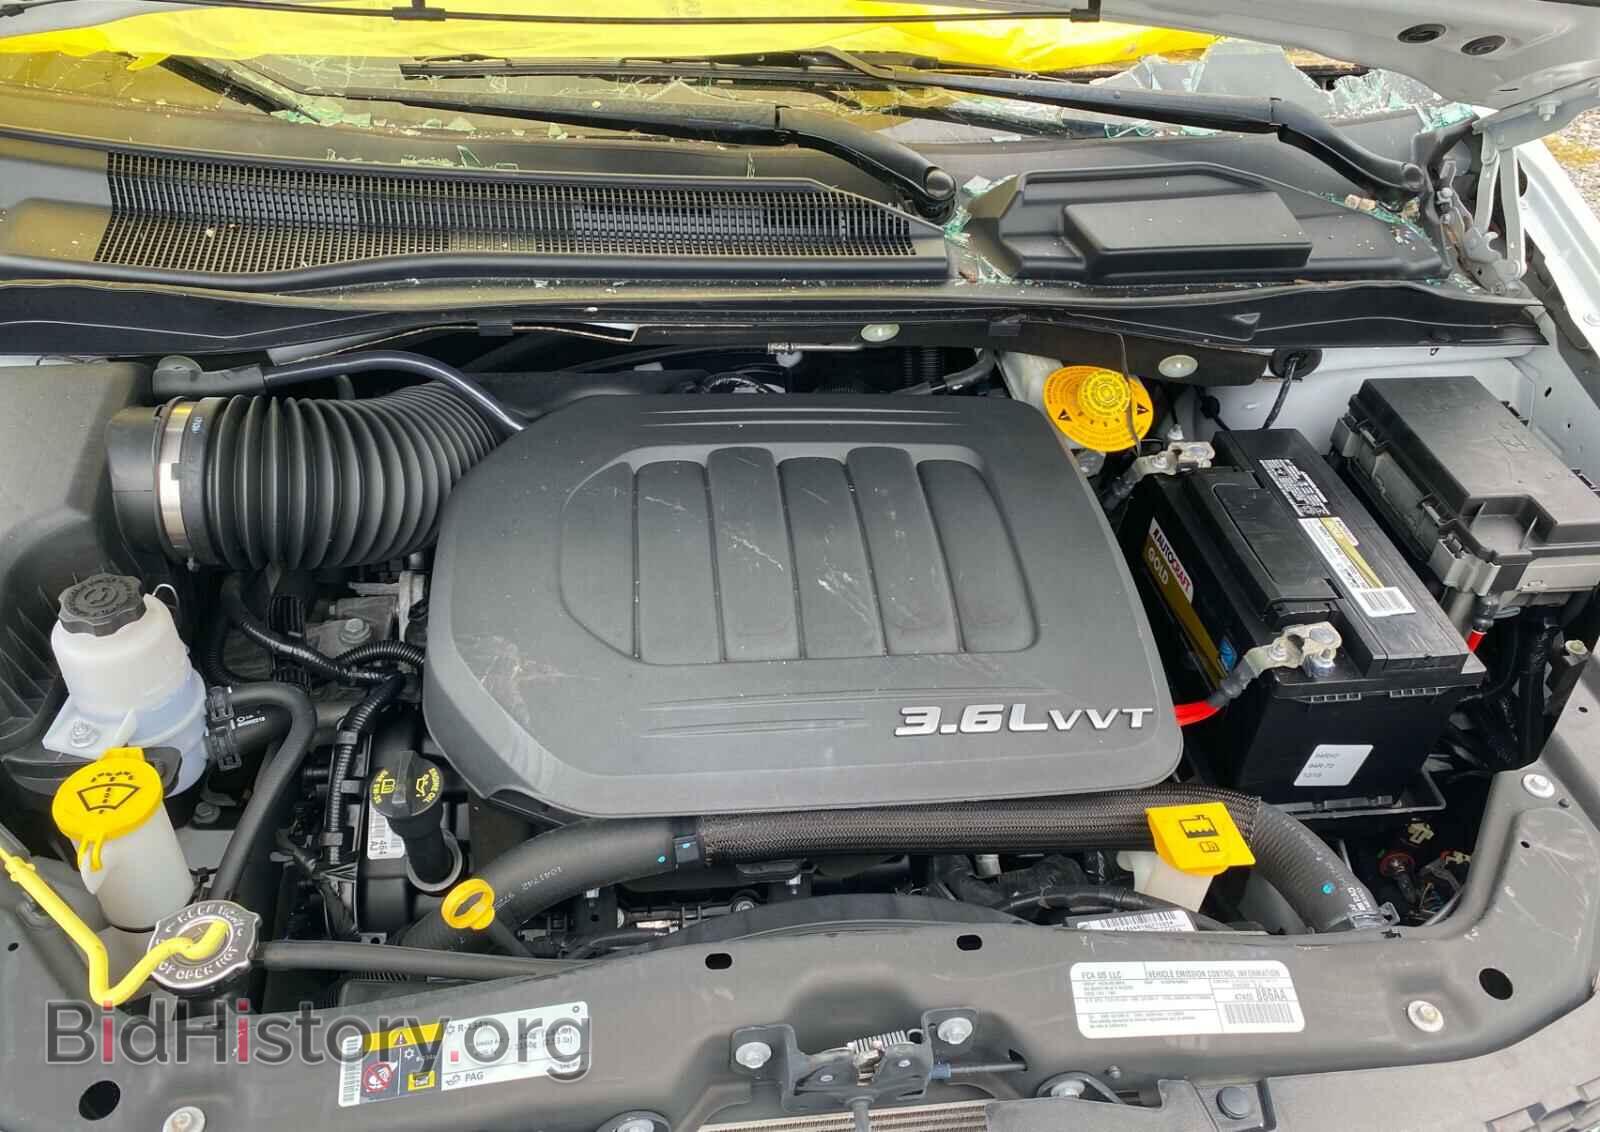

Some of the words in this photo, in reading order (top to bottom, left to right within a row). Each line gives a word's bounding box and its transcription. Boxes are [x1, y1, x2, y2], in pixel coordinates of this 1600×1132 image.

[1149, 543, 1169, 585] GOLD
[894, 703, 1048, 736] 3.6L
[1049, 708, 1153, 731] VVT
[1146, 969, 1175, 978] VEHICLE
[1207, 969, 1235, 978] CONTROL
[465, 1071, 484, 1082] PAG
